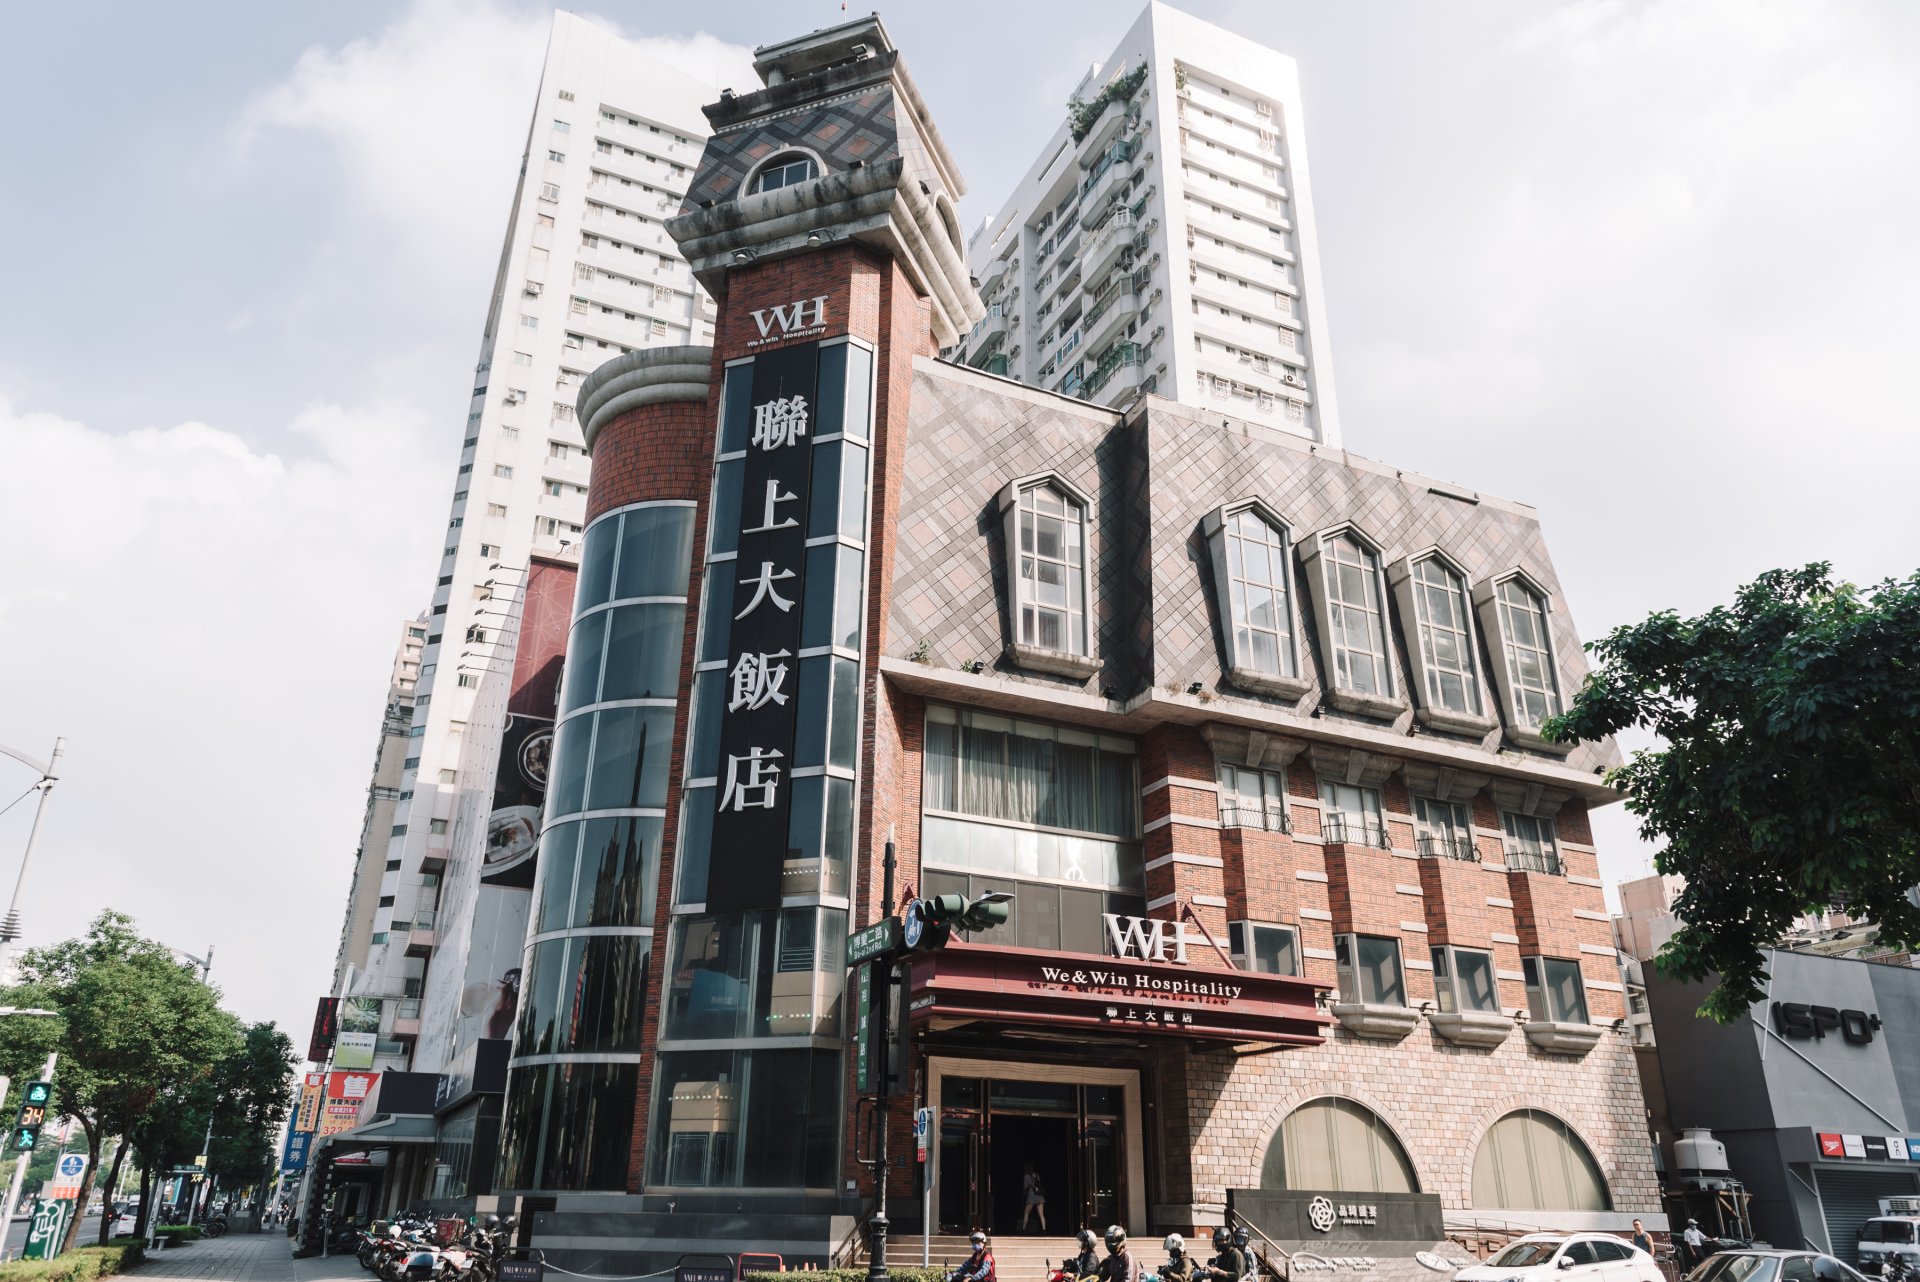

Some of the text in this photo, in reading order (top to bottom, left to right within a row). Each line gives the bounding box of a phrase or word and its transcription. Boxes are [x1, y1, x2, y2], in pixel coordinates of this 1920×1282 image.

[750, 295, 829, 338] WH
[783, 326, 826, 339] Hospitality
[719, 395, 809, 813] 聯上大飯店
[854, 926, 882, 949] 博愛二路
[1102, 913, 1191, 964] WH
[1135, 974, 1242, 998] Hospitality
[1106, 1006, 1193, 1024] 聯上大飯店
[343, 1075, 369, 1097] 售
[22, 1107, 45, 1125] 34
[289, 1132, 305, 1162] 證券
